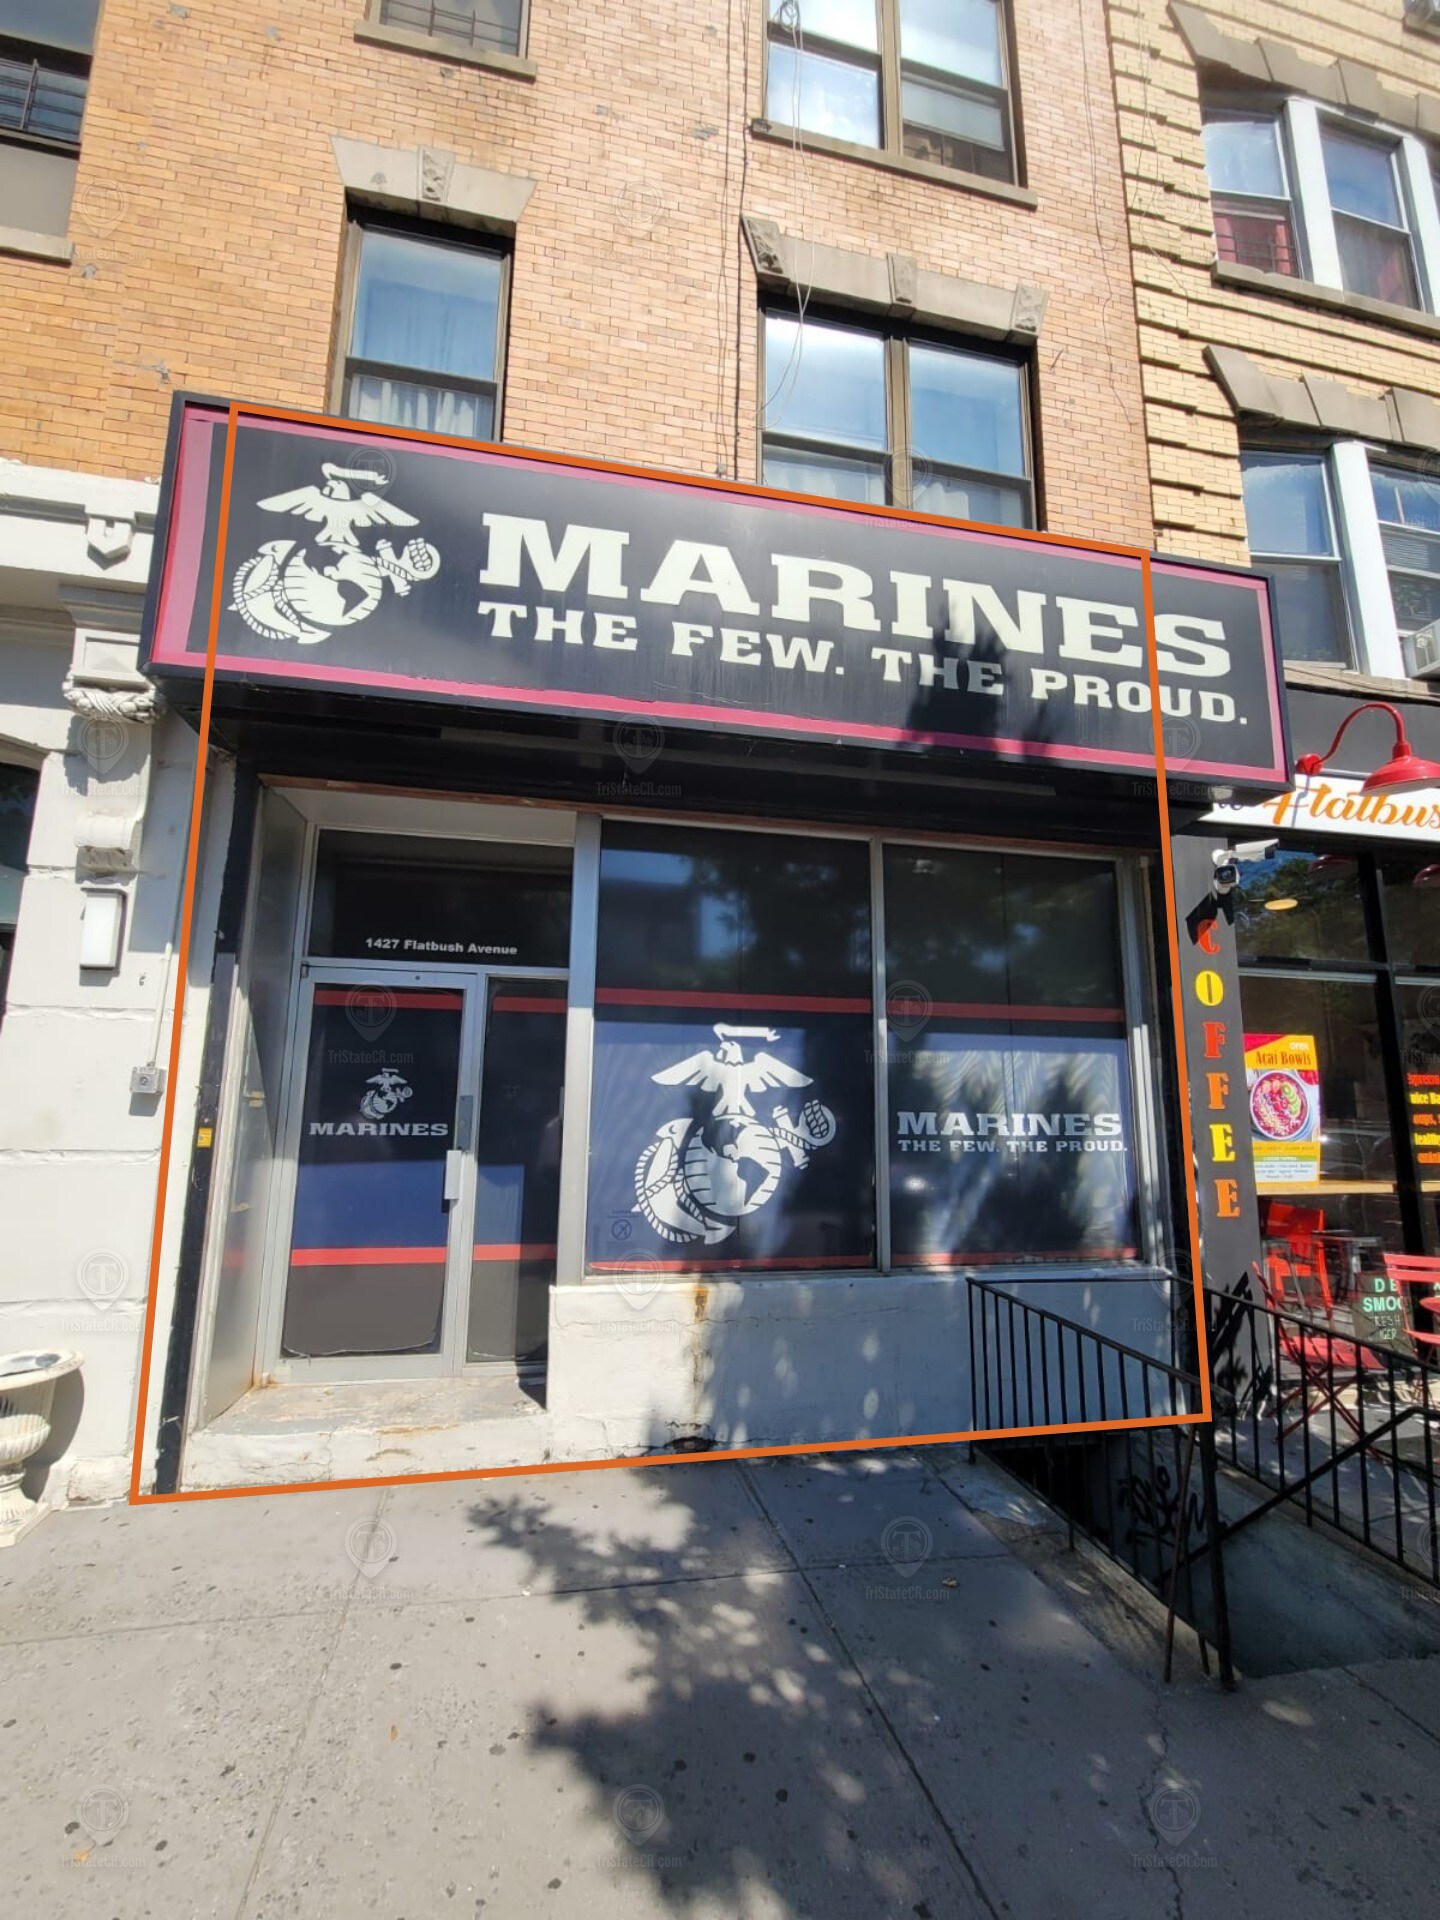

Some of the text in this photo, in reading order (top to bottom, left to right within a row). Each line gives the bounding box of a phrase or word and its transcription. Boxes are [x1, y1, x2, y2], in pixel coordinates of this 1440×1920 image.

[479, 512, 1231, 678] MARINES
[478, 601, 1248, 725] THE FEW. THE PROUD.
[365, 937, 518, 955] 1427 Flatbush Avenue
[1195, 918, 1241, 1218] COFFEE
[309, 1122, 449, 1137] MARINES
[897, 1111, 1122, 1136] MARINES
[897, 1139, 941, 1152] THE
[1006, 1140, 1048, 1152] THE
[1055, 1140, 1128, 1153] PROUD.
